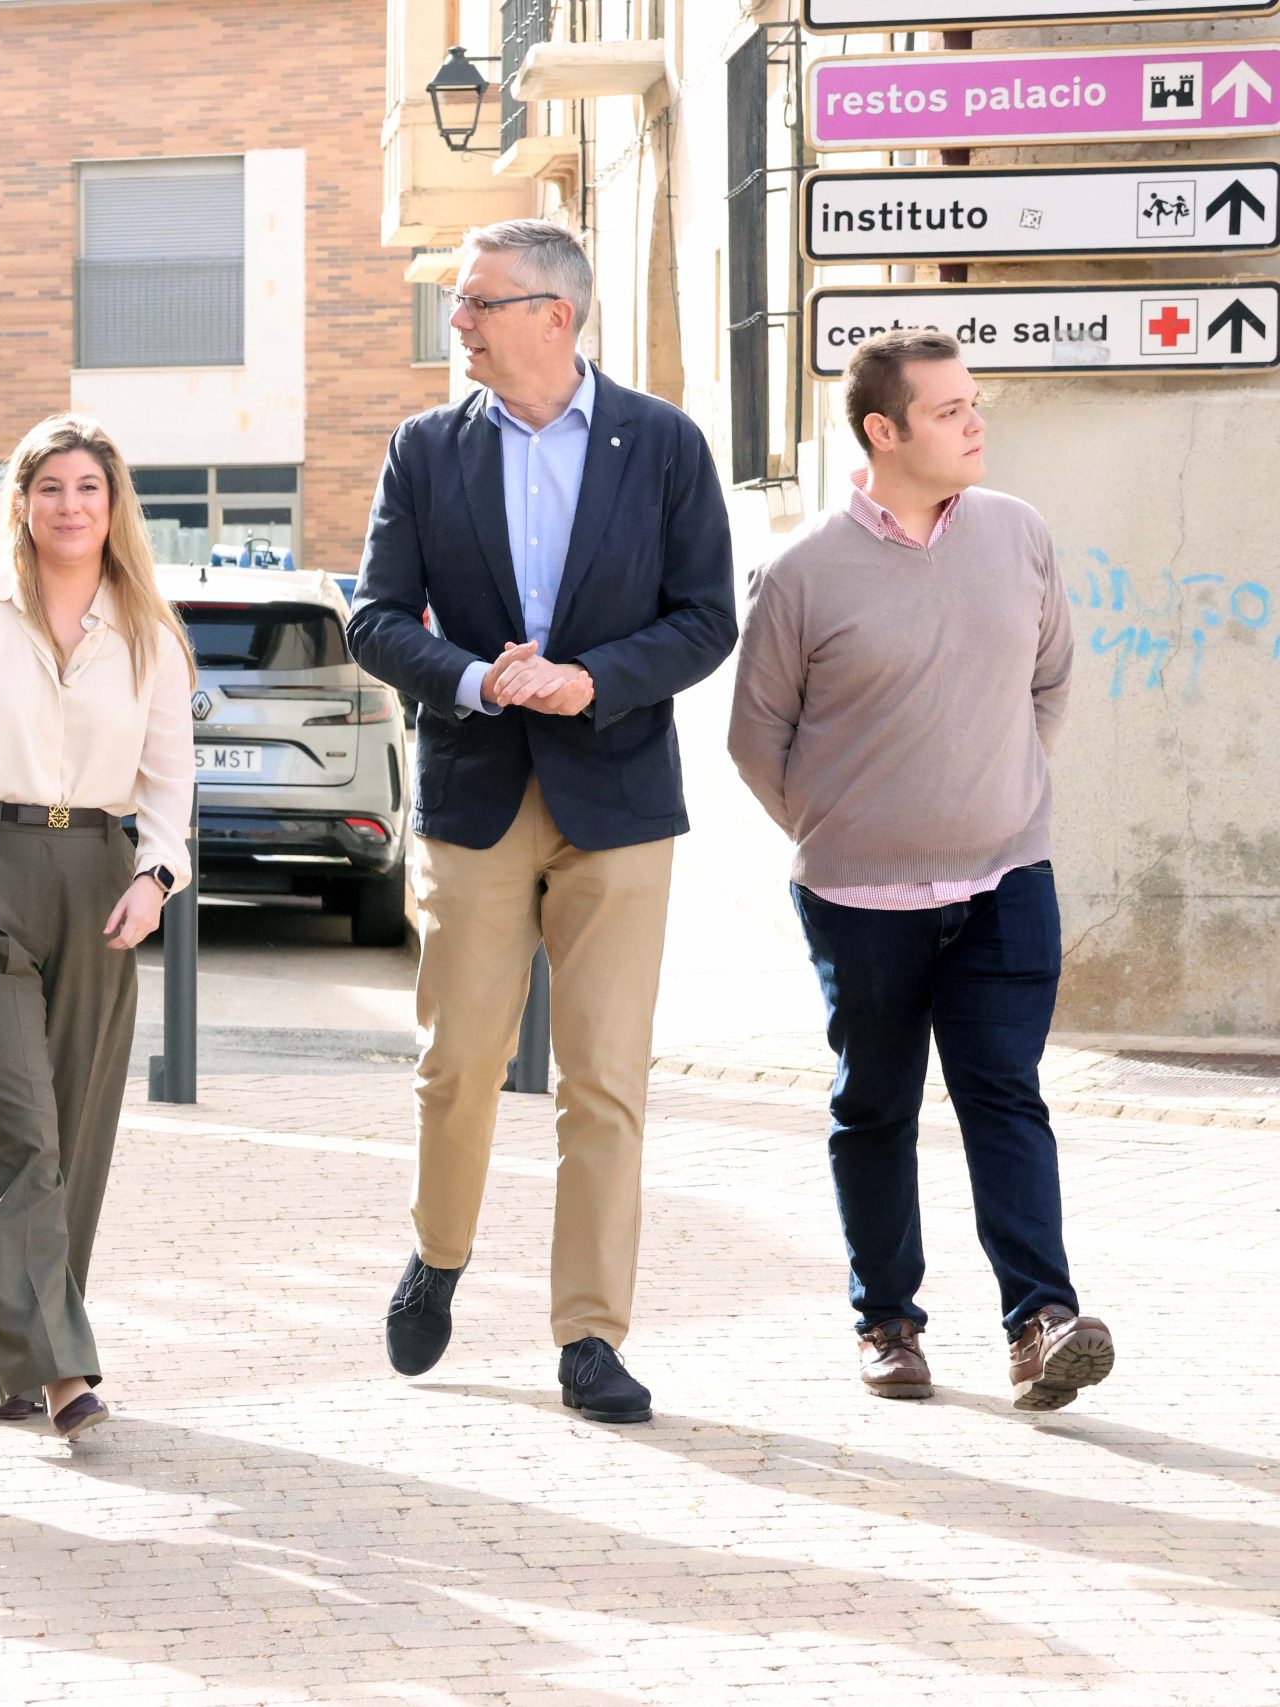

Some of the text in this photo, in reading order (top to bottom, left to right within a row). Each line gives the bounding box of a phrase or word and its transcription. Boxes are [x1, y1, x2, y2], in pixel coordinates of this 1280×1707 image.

[827, 77, 1107, 117] restos palacio
[822, 200, 989, 232] instituto
[956, 317, 998, 344] de
[1012, 314, 1108, 344] salud
[214, 750, 255, 768] MST
